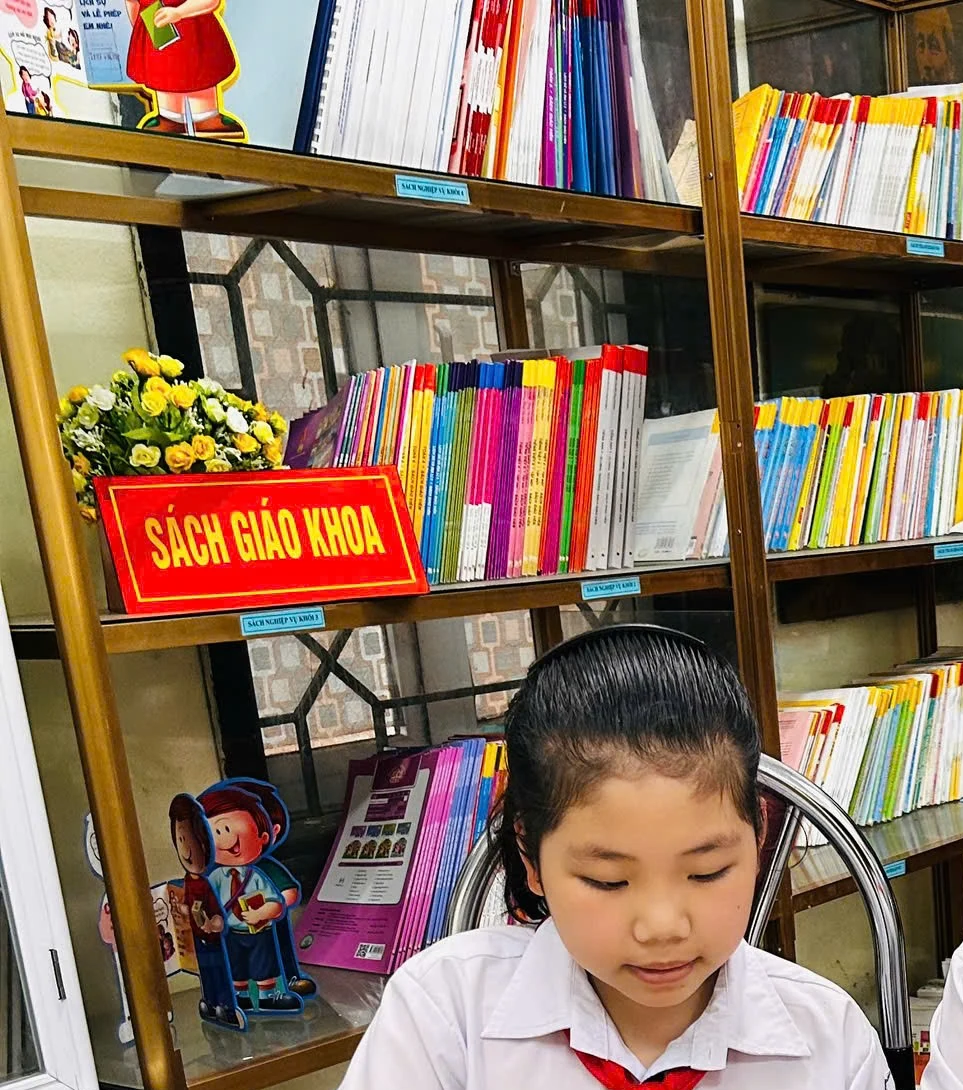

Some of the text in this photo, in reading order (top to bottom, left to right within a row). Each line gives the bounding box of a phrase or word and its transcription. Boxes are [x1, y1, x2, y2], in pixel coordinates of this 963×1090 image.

[144, 497, 385, 569] SÁCH GIÁO KHOA
[247, 620, 264, 628] SÁCH
[265, 617, 289, 627] NGHIỆP
[289, 616, 298, 625] VỤ
[298, 614, 315, 622] KHỐI
